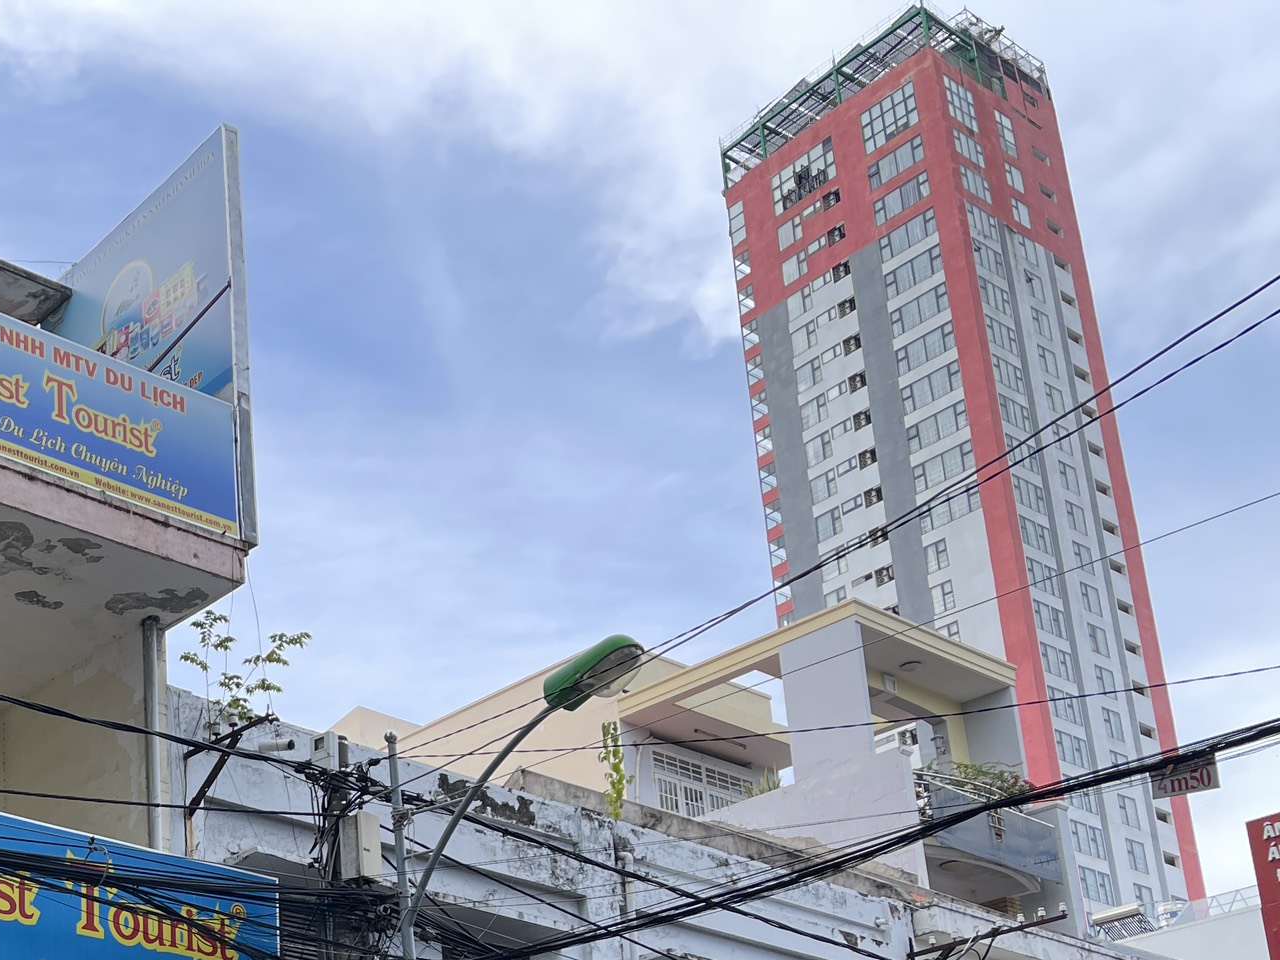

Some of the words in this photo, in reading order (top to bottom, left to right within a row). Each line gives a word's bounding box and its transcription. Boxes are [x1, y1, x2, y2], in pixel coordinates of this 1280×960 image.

[43, 369, 160, 457] Tourist
[53, 345, 97, 378] MTV
[105, 366, 133, 392] DU
[140, 381, 186, 414] LỊCH
[0, 415, 25, 439] Du
[29, 427, 66, 454] Lịch
[71, 442, 129, 477] Chuyên
[132, 463, 189, 501] Nghiệp
[94, 476, 129, 498] Website:
[130, 491, 232, 532] www.sanesttourist.com.vn
